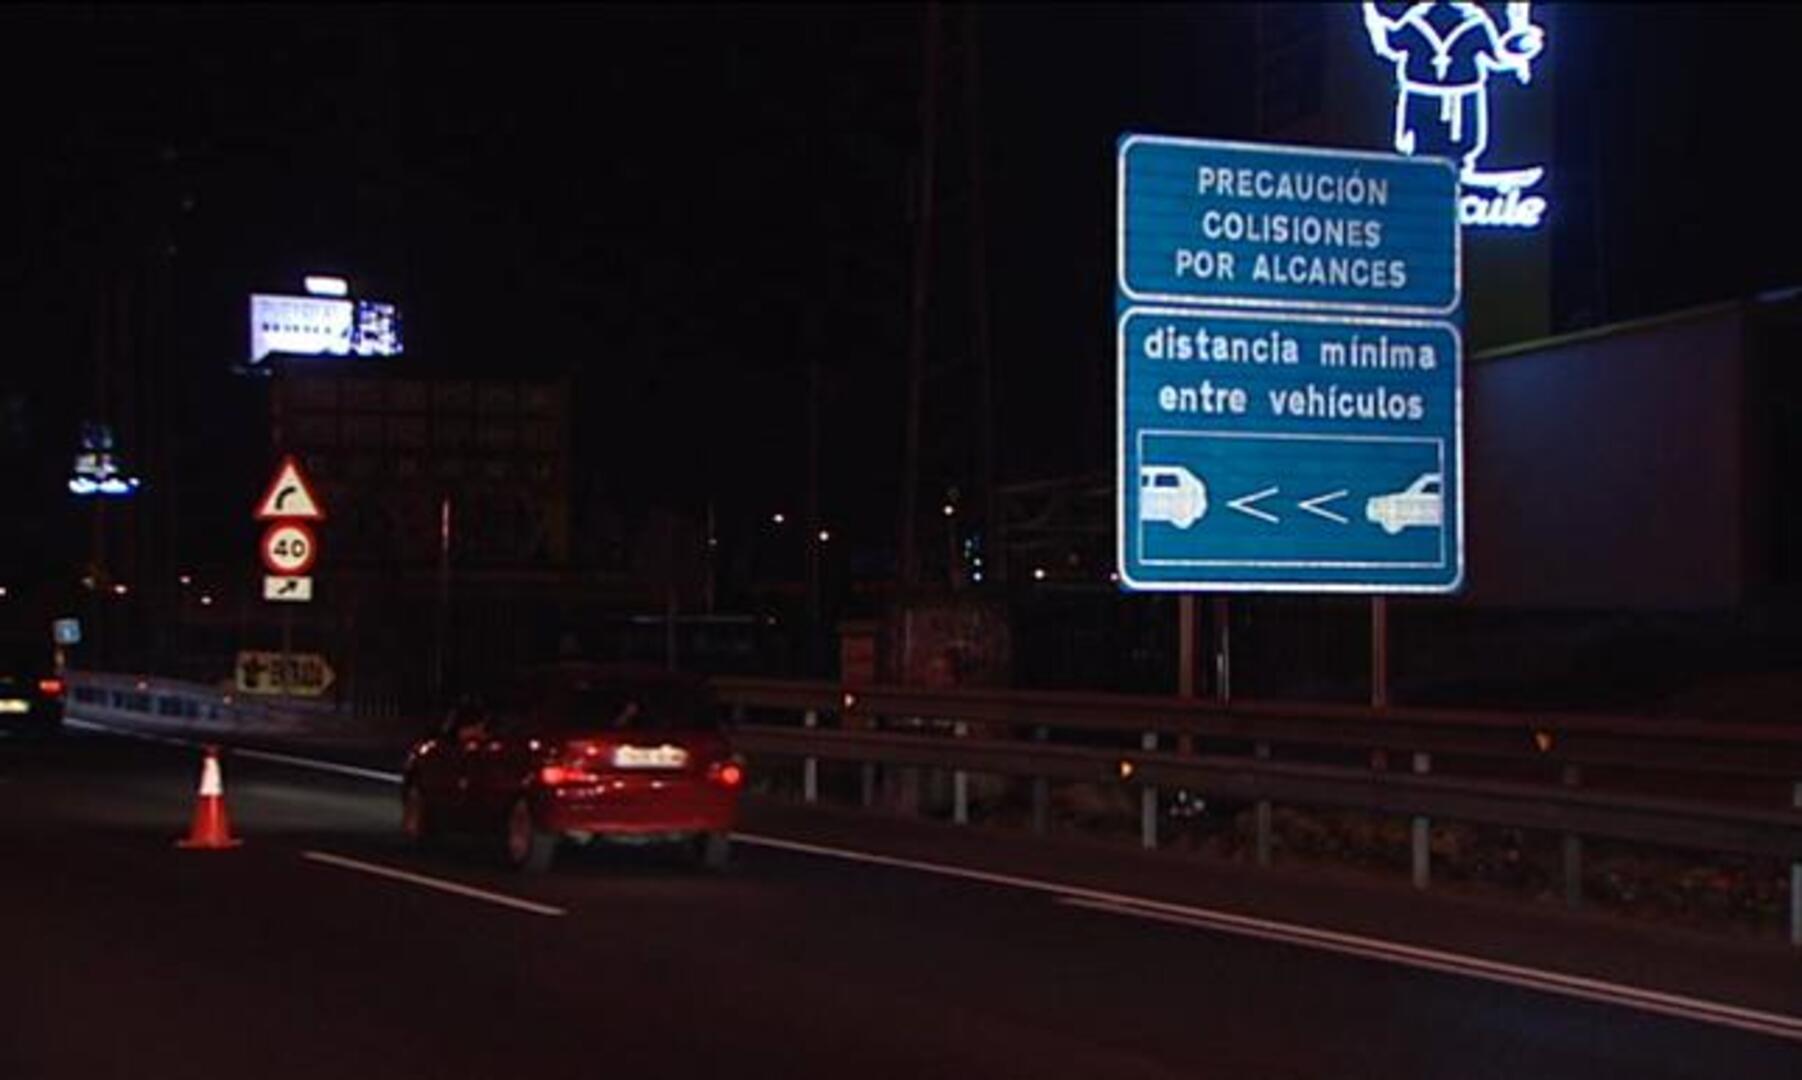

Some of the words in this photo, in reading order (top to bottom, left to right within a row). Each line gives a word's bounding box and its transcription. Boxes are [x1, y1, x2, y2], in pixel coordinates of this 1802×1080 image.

[1198, 166, 1389, 207] PRECAUCIÓN
[1202, 210, 1382, 249] COLISIONES
[1175, 248, 1235, 280] POR
[1252, 253, 1406, 288] ALCANCES
[1143, 325, 1299, 364] distancia
[1319, 334, 1437, 370] mínima
[1158, 379, 1248, 414] entre
[1268, 382, 1424, 420] vehículos
[273, 538, 306, 559] 40
